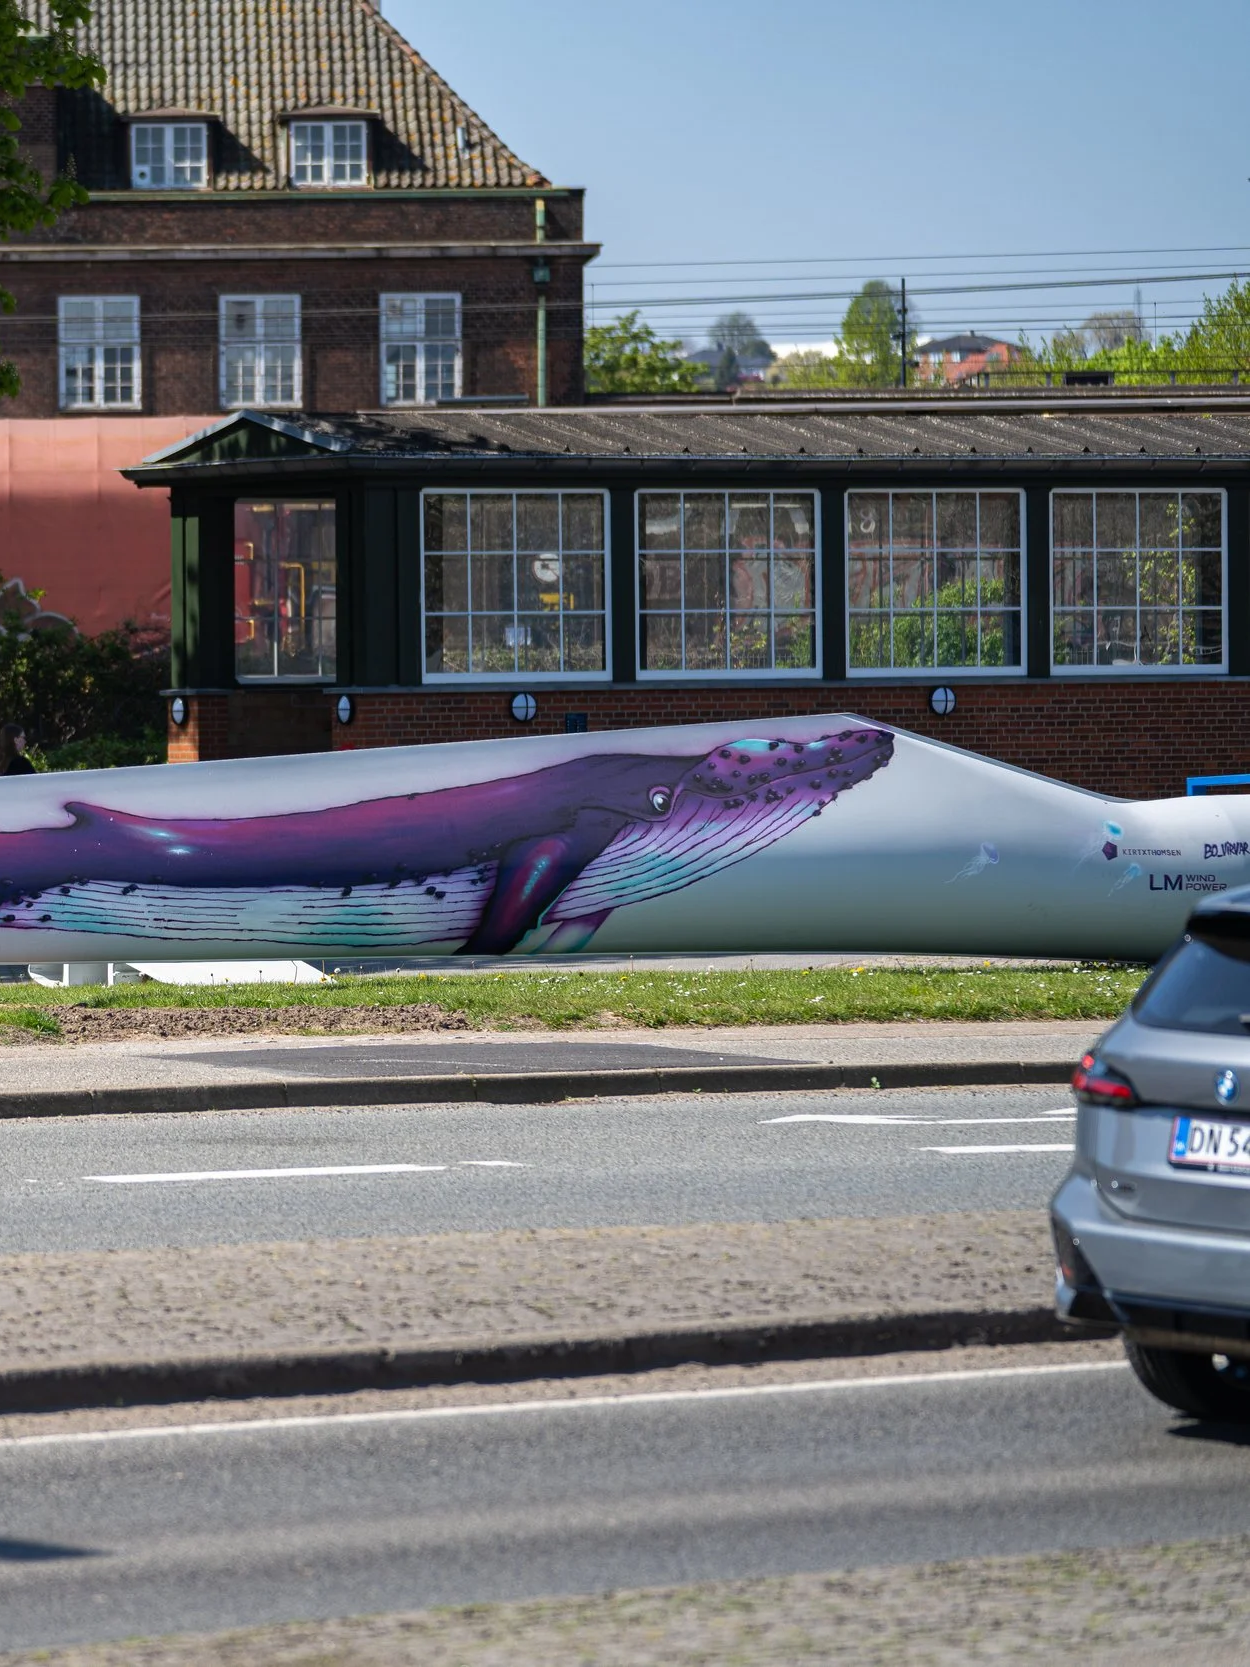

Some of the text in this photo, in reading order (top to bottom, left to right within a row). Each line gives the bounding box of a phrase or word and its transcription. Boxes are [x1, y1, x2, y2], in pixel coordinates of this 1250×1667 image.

[1149, 874, 1216, 891] LM WIND
[1185, 883, 1228, 892] POWER
[1189, 1126, 1222, 1155] DN
